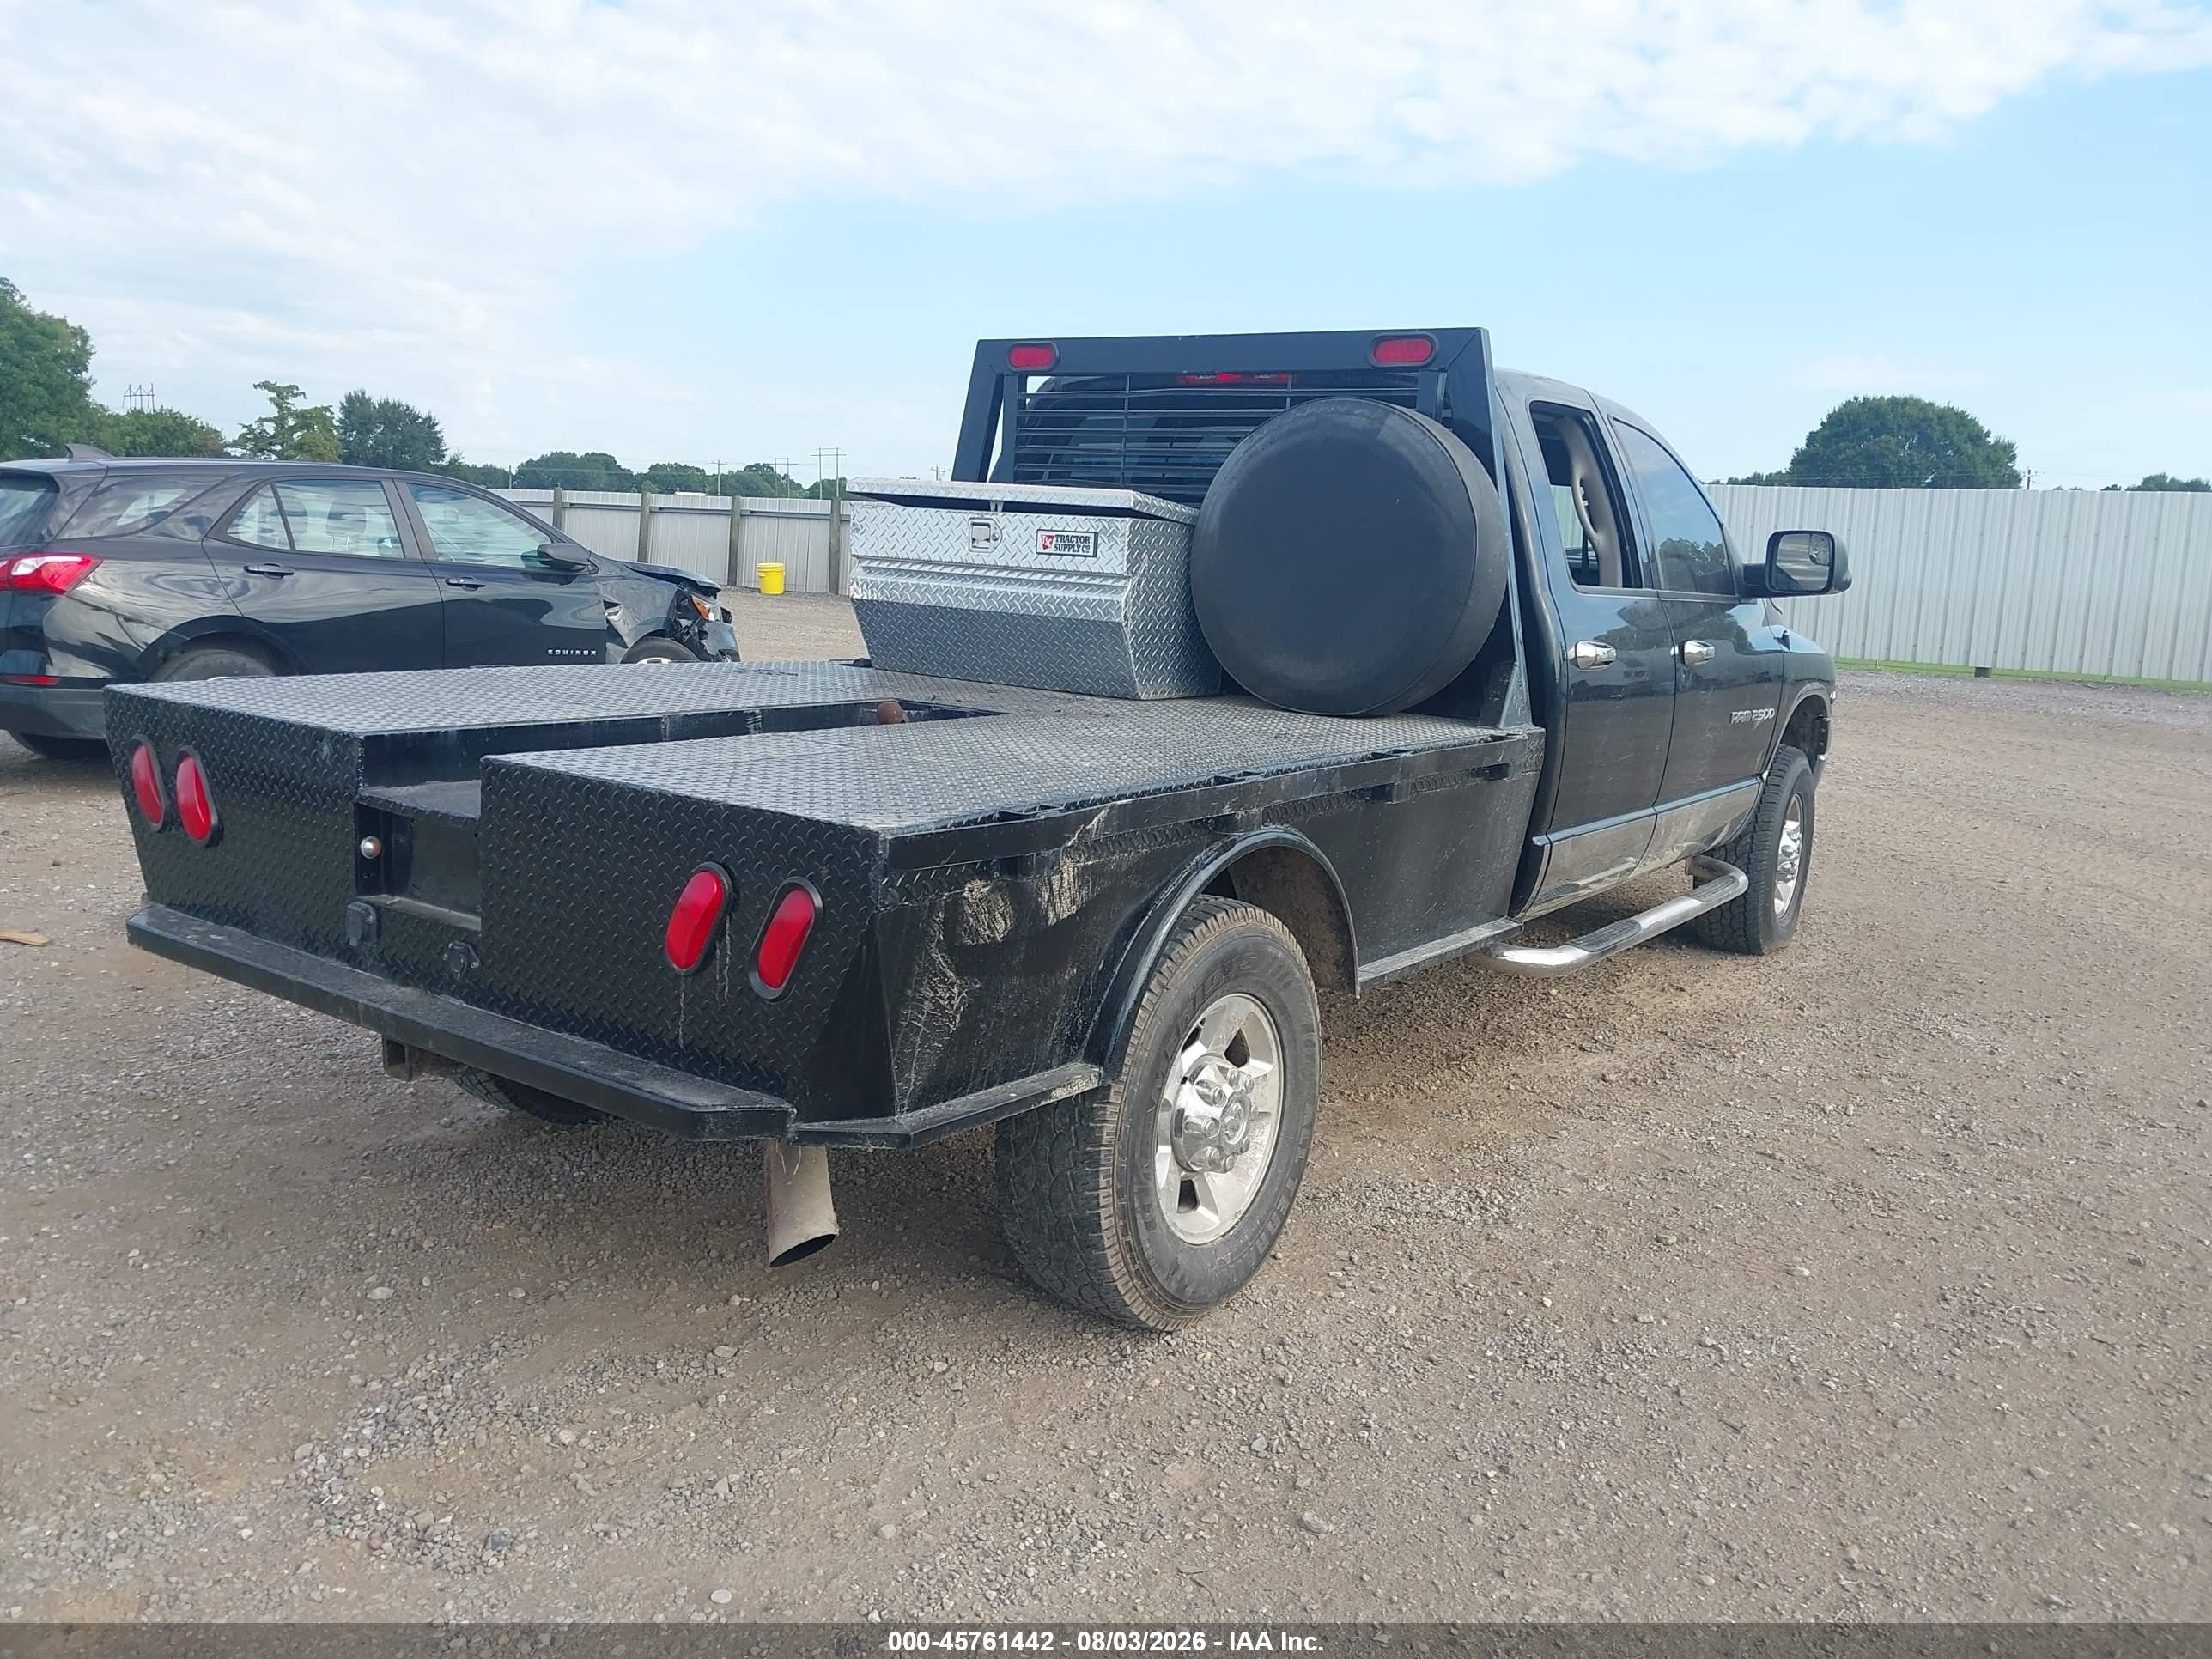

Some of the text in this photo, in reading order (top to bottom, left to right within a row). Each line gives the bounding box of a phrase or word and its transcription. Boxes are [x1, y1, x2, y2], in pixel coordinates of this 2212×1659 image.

[1054, 534, 1091, 544] TRACTOR
[1054, 543, 1081, 553] SUPPLY
[1730, 708, 1775, 724] RAM 2500
